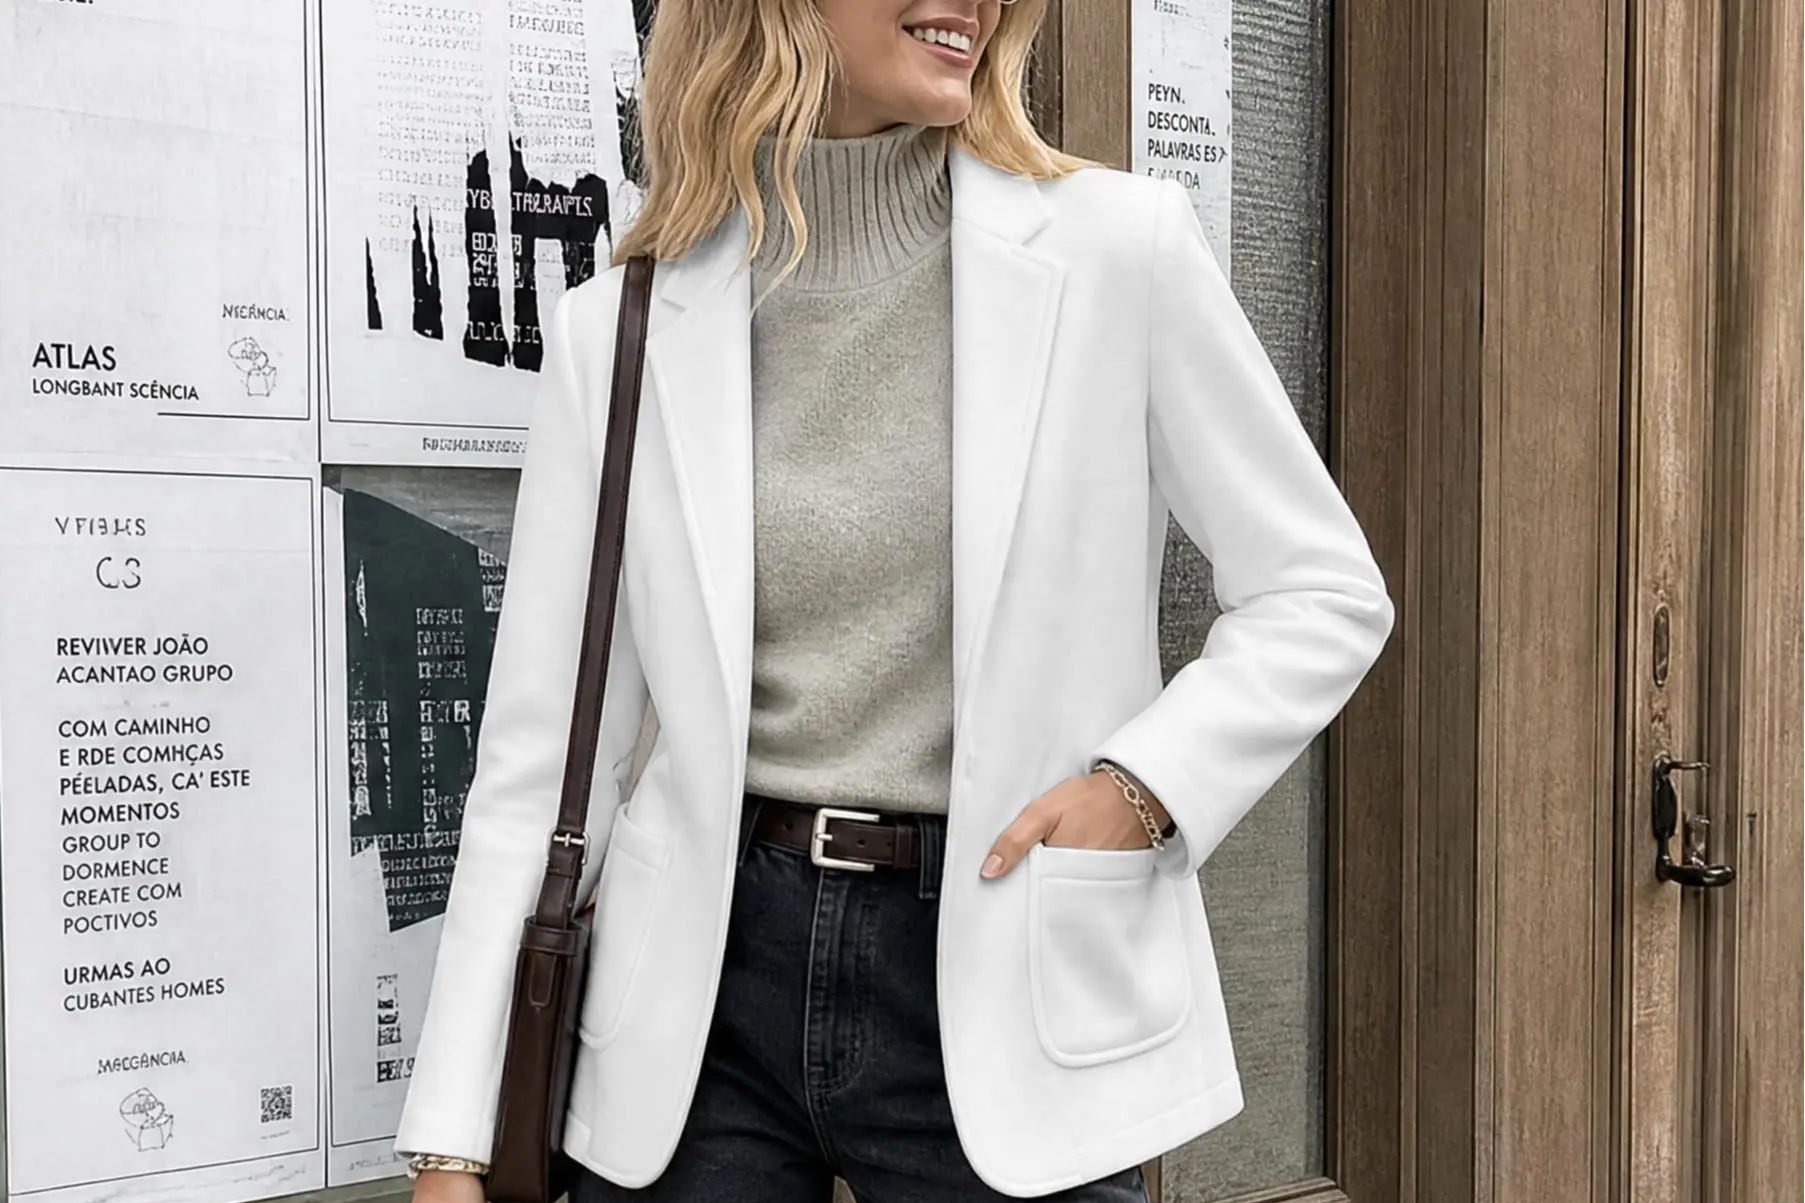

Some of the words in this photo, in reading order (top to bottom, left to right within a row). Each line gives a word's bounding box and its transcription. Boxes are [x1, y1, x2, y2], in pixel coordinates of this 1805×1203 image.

[1148, 139, 1201, 161] PALAVRAS
[32, 343, 116, 371] ATLAS
[33, 378, 124, 397] LONGBANT
[153, 634, 208, 655] JOÃO
[57, 665, 156, 683] ACANTAO
[163, 664, 233, 682] GRUPO
[59, 720, 107, 738] COM
[115, 716, 210, 736] CAMINHO
[60, 749, 69, 766] E
[78, 747, 115, 766] RDE
[211, 770, 250, 788] ESTE
[61, 802, 180, 825] MOMENTOS
[63, 834, 130, 853] GROUP
[136, 832, 160, 848] TO
[63, 858, 168, 881] DORMENCE
[63, 886, 130, 907] CREATE
[137, 882, 181, 901] COM
[64, 910, 157, 934] POCTIVOS
[64, 962, 134, 985] URMAS
[141, 959, 170, 977] AO
[64, 987, 155, 1011] CUBANTES
[161, 978, 224, 1000] HOMES
